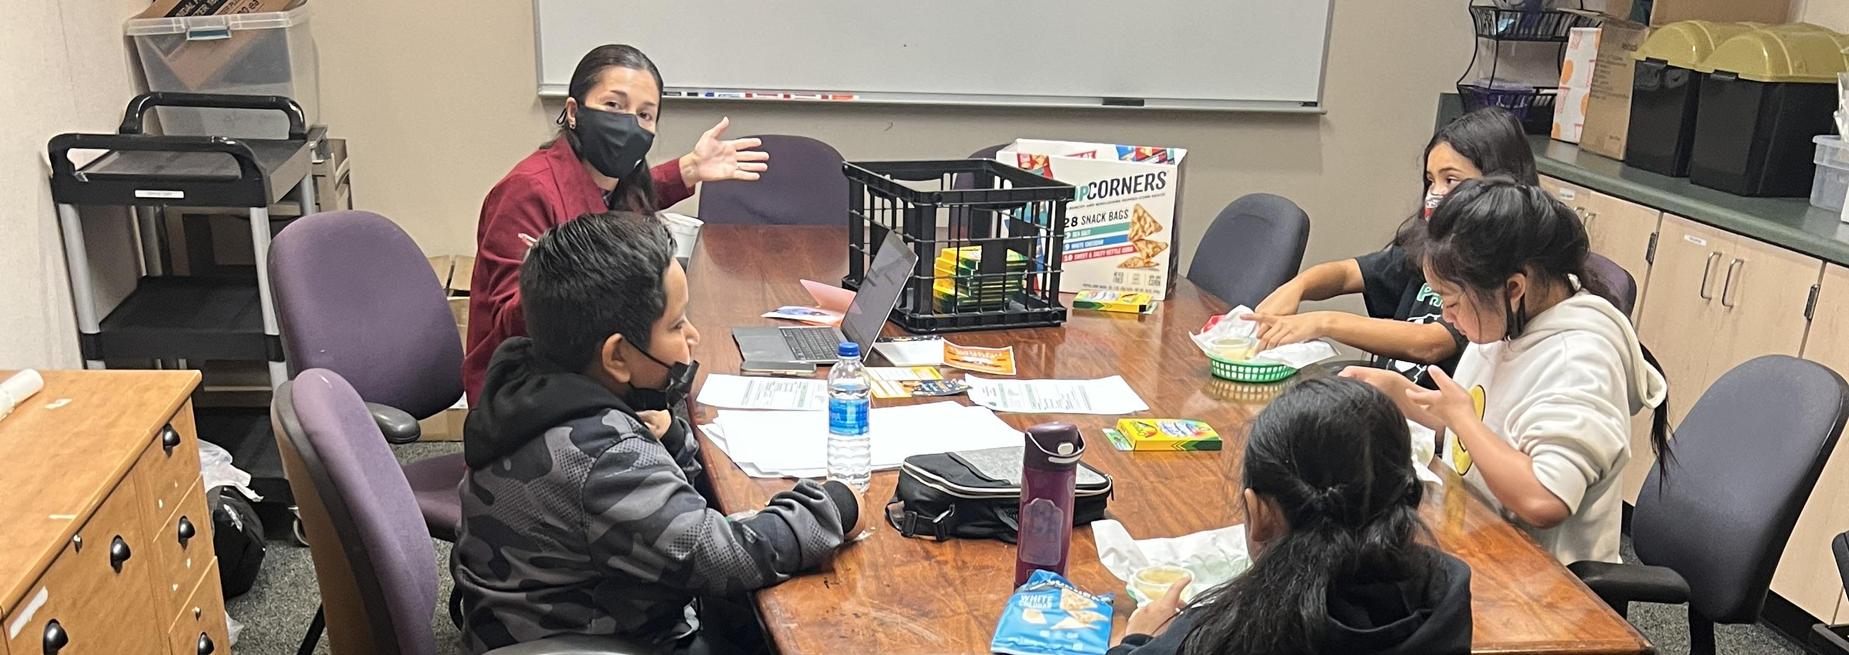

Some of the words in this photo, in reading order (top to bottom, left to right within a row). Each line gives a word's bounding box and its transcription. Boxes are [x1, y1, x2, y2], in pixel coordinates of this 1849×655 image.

[1074, 171, 1167, 201] PCORNERS
[1064, 216, 1078, 228] 28
[1081, 212, 1107, 225] SNACK
[1108, 209, 1129, 222] BAGS
[1063, 254, 1073, 262] 10
[1020, 594, 1055, 603] WHITE
